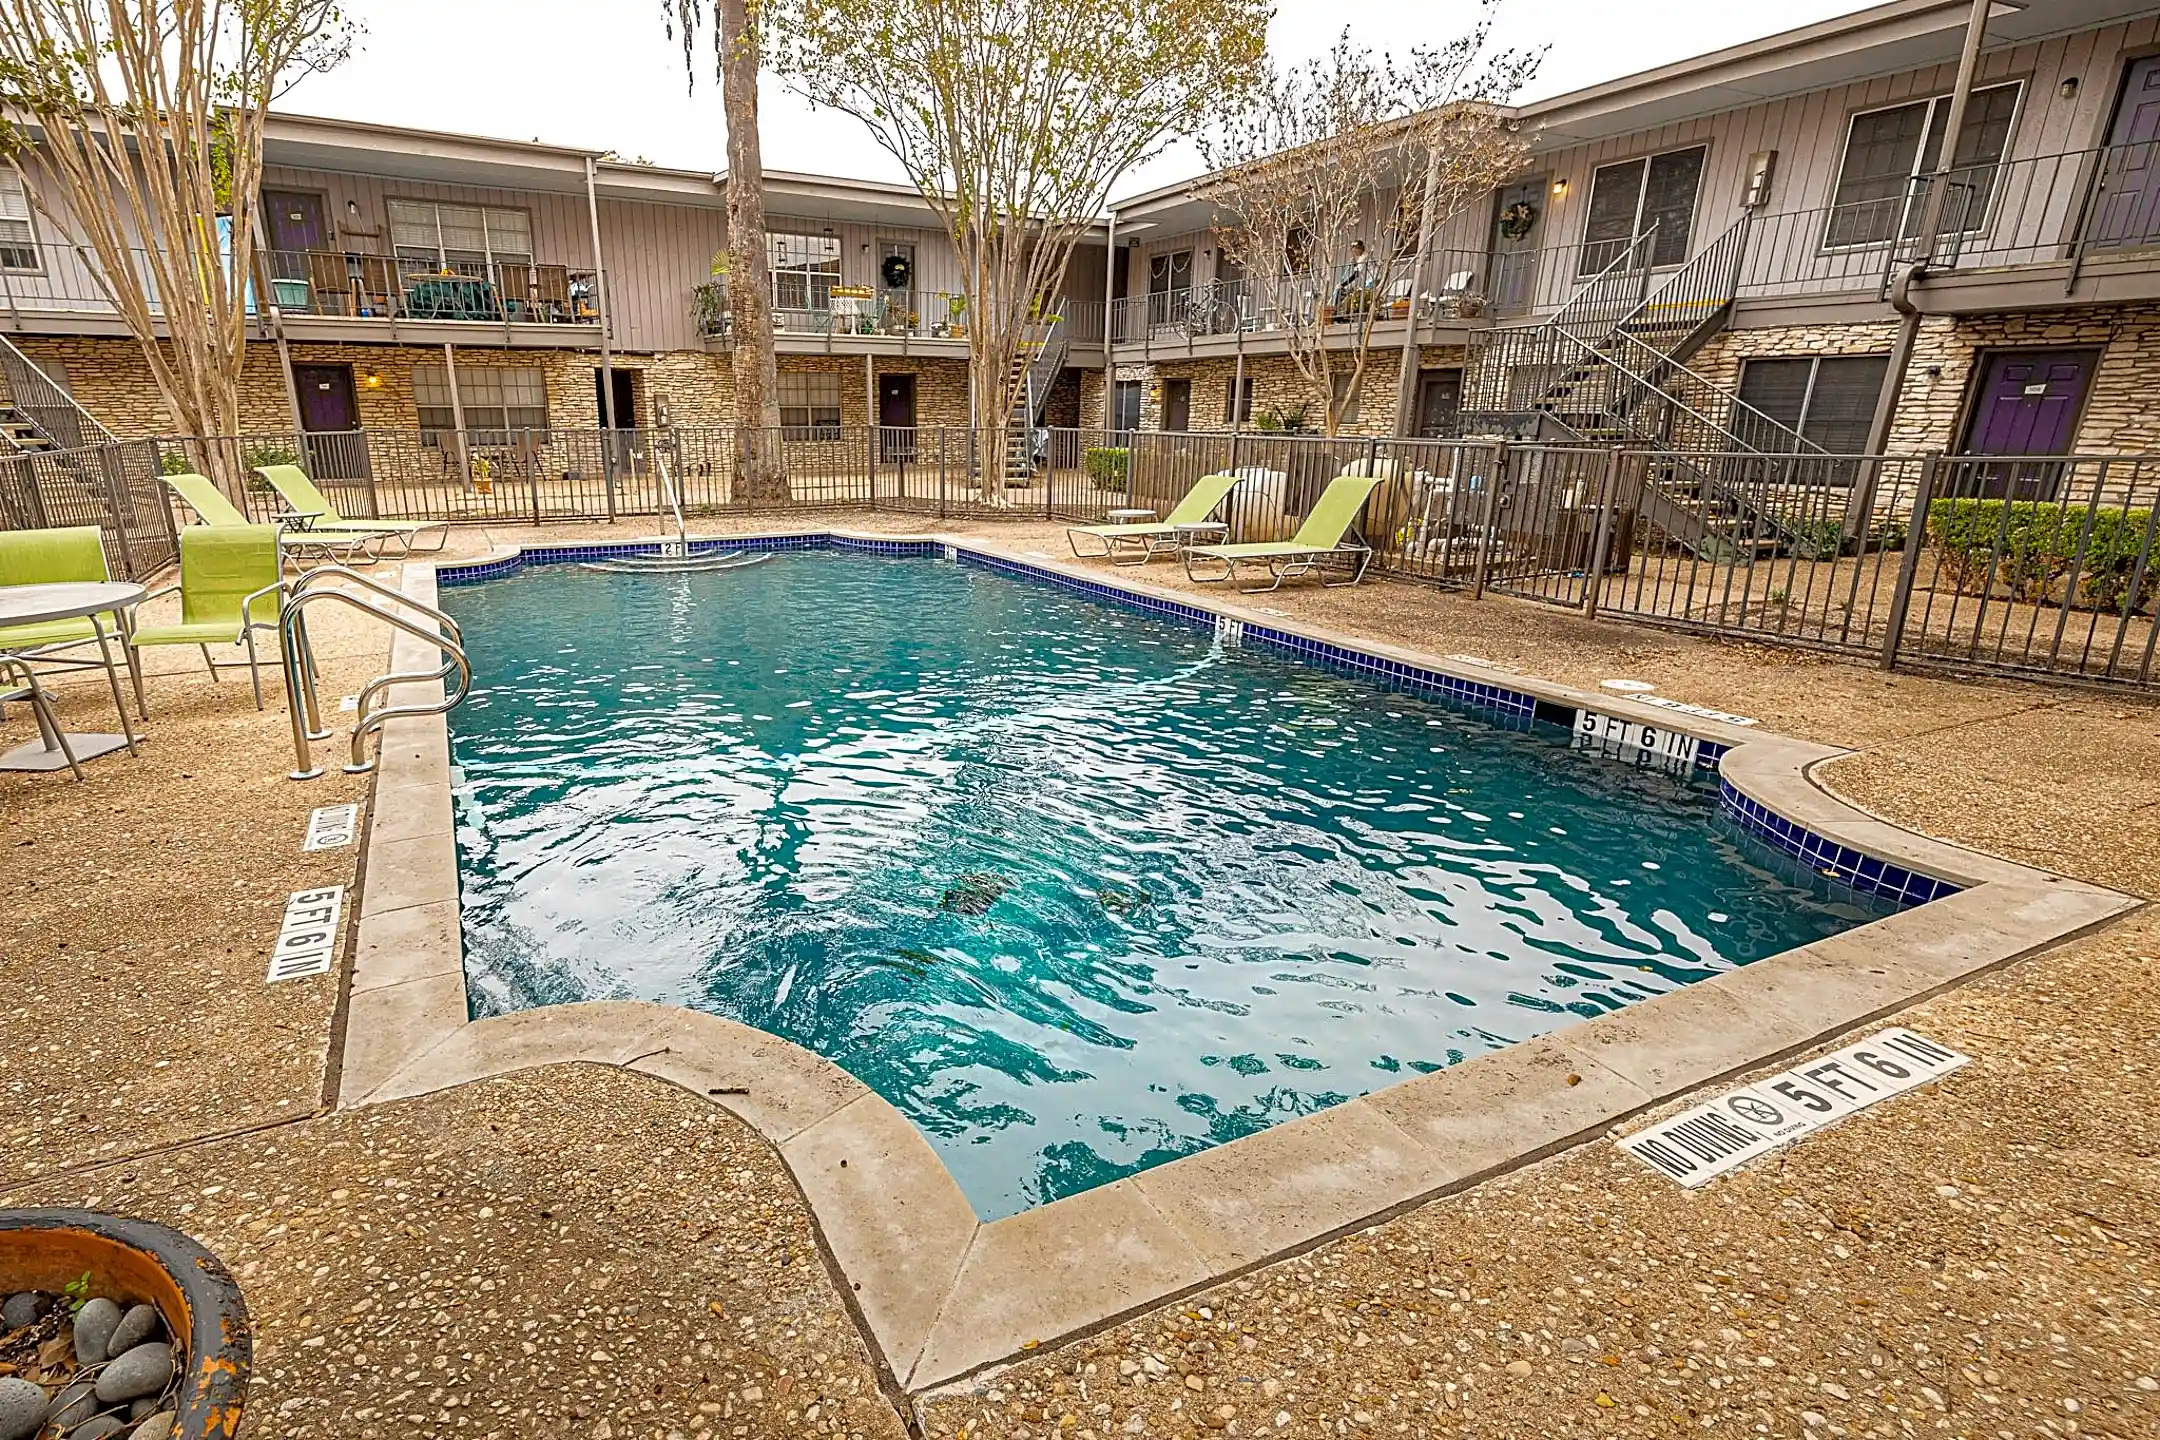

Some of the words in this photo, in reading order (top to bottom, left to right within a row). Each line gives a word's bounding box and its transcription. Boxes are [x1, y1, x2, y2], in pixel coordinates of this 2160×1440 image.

[665, 543, 672, 555] 2
[1219, 616, 1226, 630] 5
[1230, 619, 1241, 638] FT
[1582, 713, 1597, 732] 5
[1606, 718, 1632, 746] FT
[1640, 726, 1656, 748] 6
[1667, 732, 1694, 760] IN
[297, 891, 336, 904] 5
[290, 906, 334, 926] FT
[285, 932, 327, 947] 6
[276, 952, 324, 977] IN
[1883, 1033, 1955, 1067] IN
[1853, 1052, 1911, 1079] 6
[1804, 1062, 1878, 1100] FT
[1771, 1080, 1833, 1112] 5
[1661, 1112, 1761, 1163] DIVING
[1631, 1139, 1698, 1178] NO
